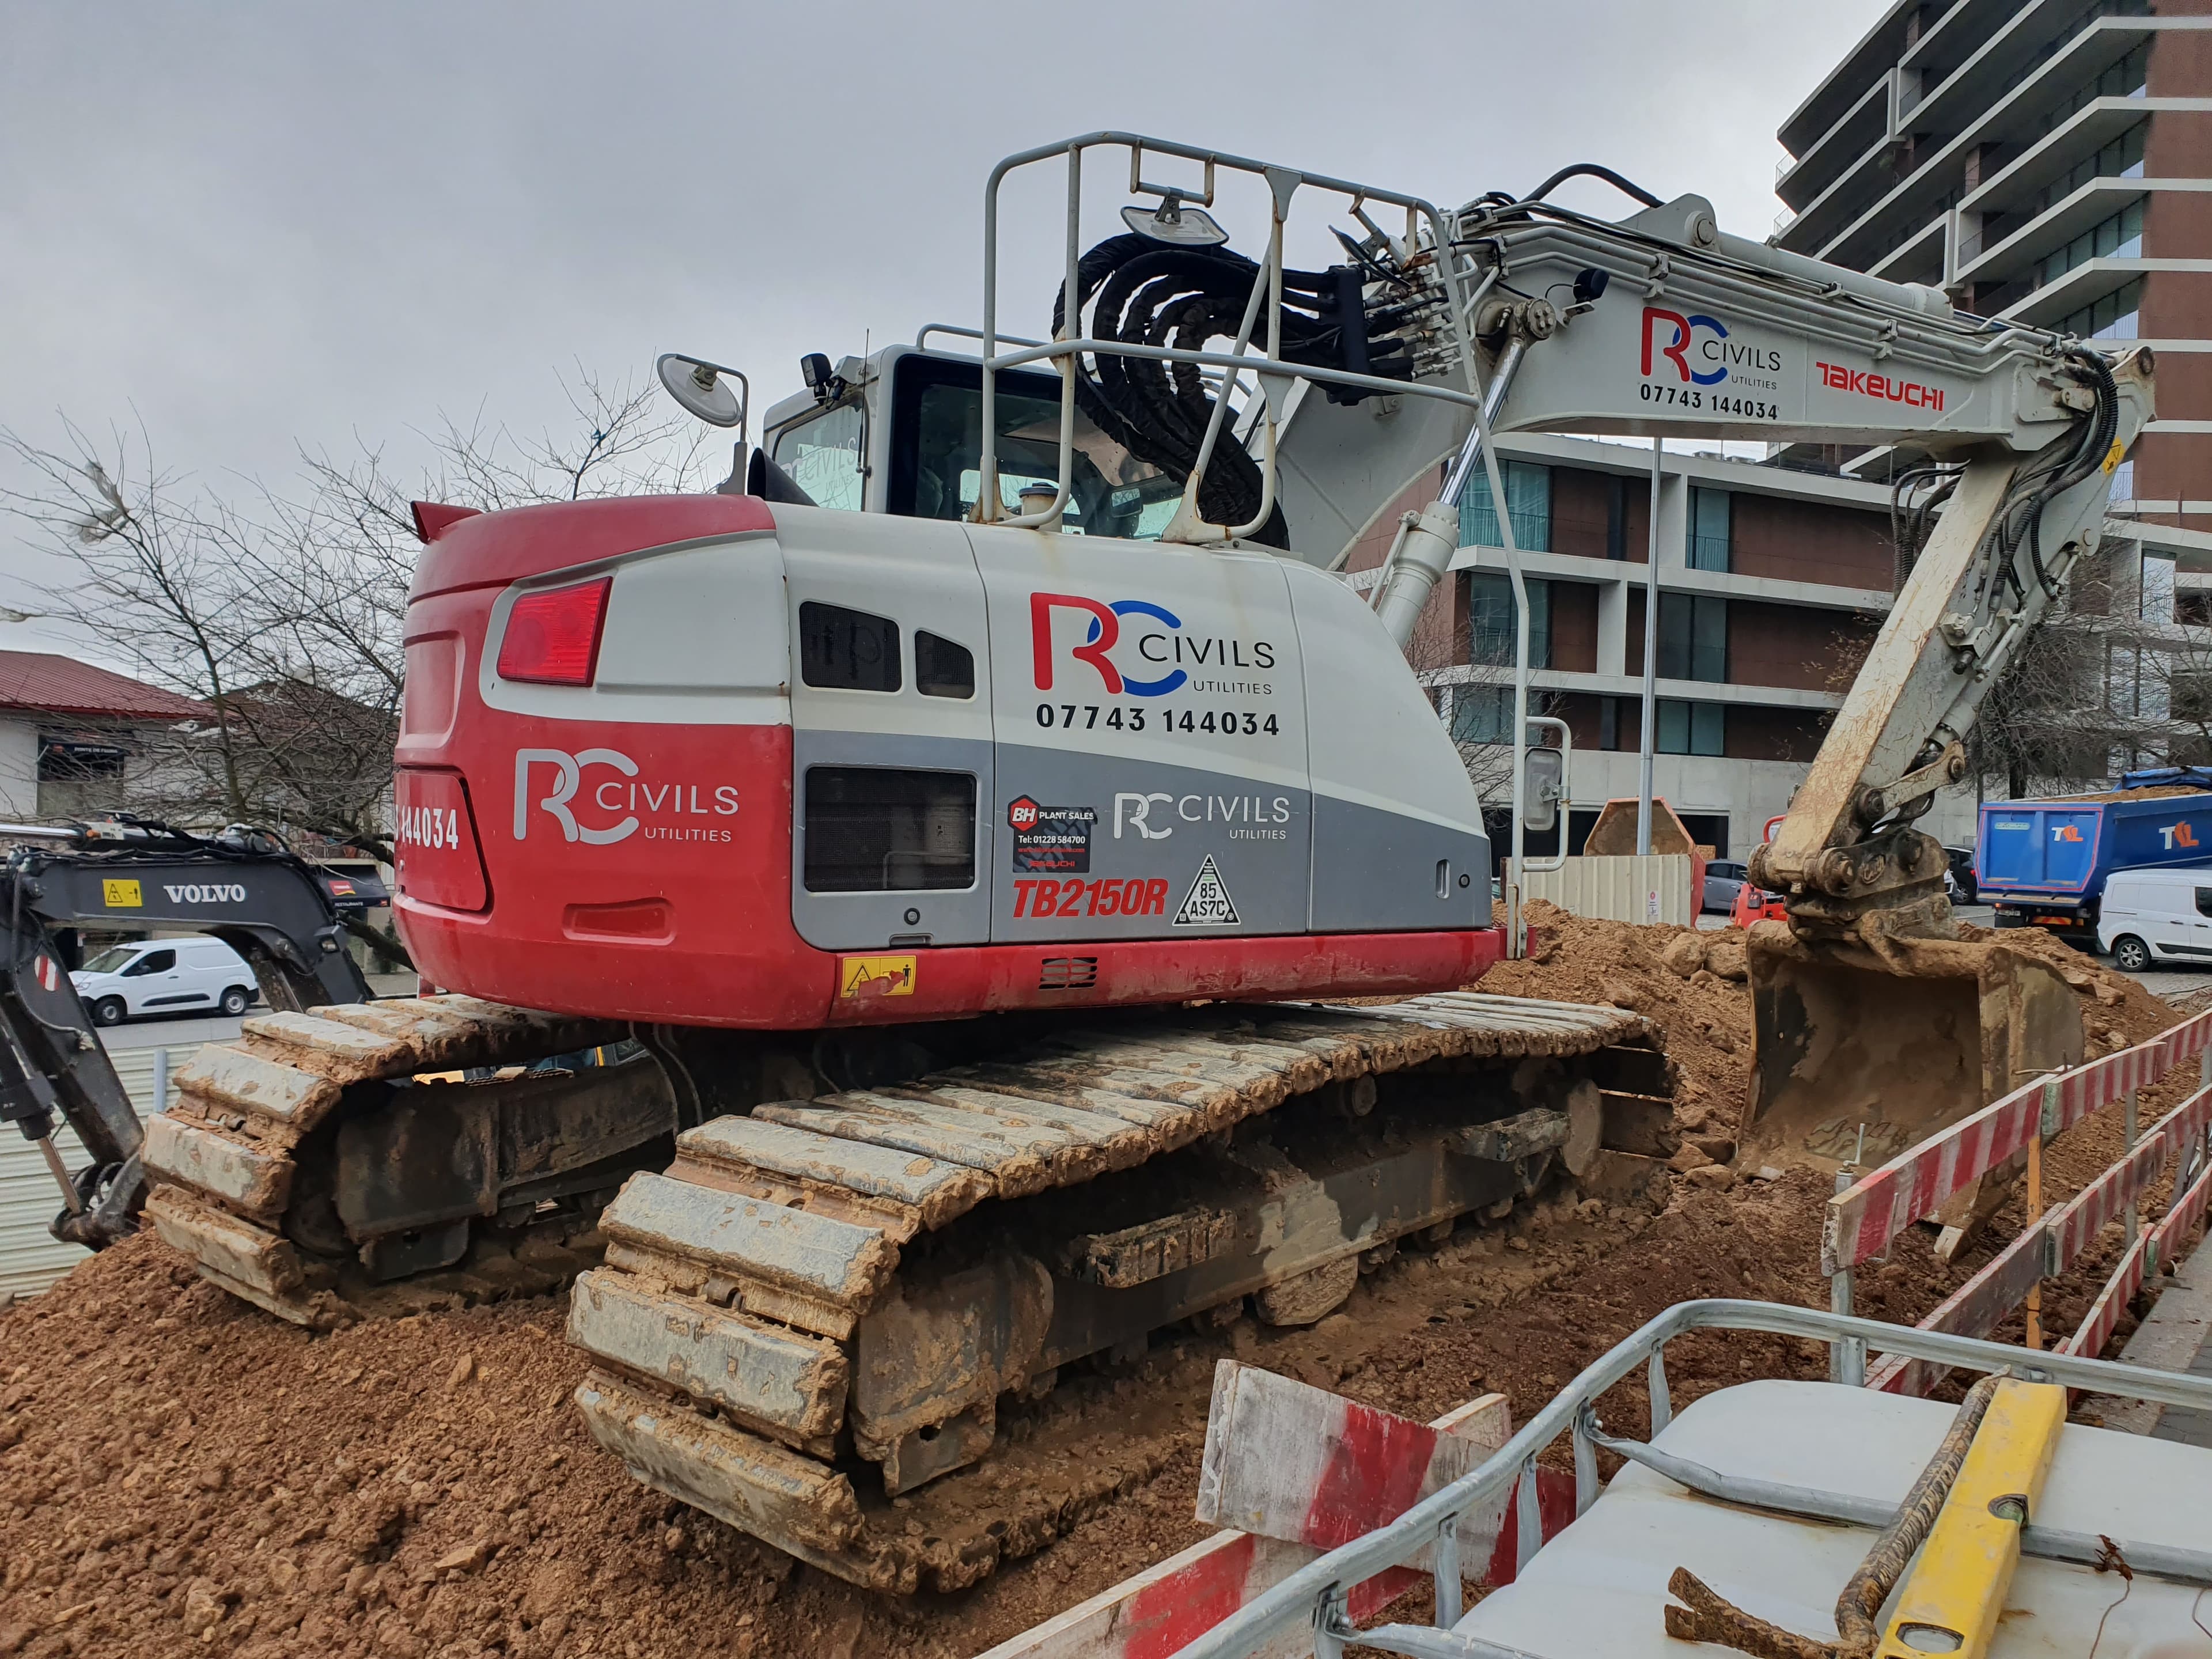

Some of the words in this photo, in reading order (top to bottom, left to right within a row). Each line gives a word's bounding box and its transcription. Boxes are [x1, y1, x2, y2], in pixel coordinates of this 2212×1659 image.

[1641, 306, 1728, 385] RC
[1702, 340, 1781, 372] CIVILS
[1731, 375, 1777, 390] UTILITIES
[1816, 362, 1944, 411] TAKEUCHI
[1641, 384, 1702, 408] 07743
[1712, 395, 1778, 420] 144034
[1031, 592, 1187, 697] RC
[1139, 634, 1275, 669] CIVILS
[1193, 680, 1272, 695] UTILITIES
[1036, 703, 1146, 731] 07743
[1162, 709, 1279, 736] 144034
[514, 748, 639, 844] RC
[595, 781, 739, 816] CIVILS
[1012, 808, 1036, 822] BH
[1039, 811, 1066, 820] PLANT
[1113, 793, 1173, 839] RC
[1178, 794, 1290, 823] CIVILS
[645, 826, 732, 843] UTILITIES
[1018, 835, 1032, 843] Tel:
[1033, 836, 1056, 844] 01228
[1057, 836, 1085, 844] 584700
[1229, 830, 1286, 839] UTILITIES
[163, 884, 245, 903] VOLVO
[1013, 879, 1169, 918] TB2150R
[1200, 882, 1217, 899] 85
[1190, 900, 1225, 917] AS7C
